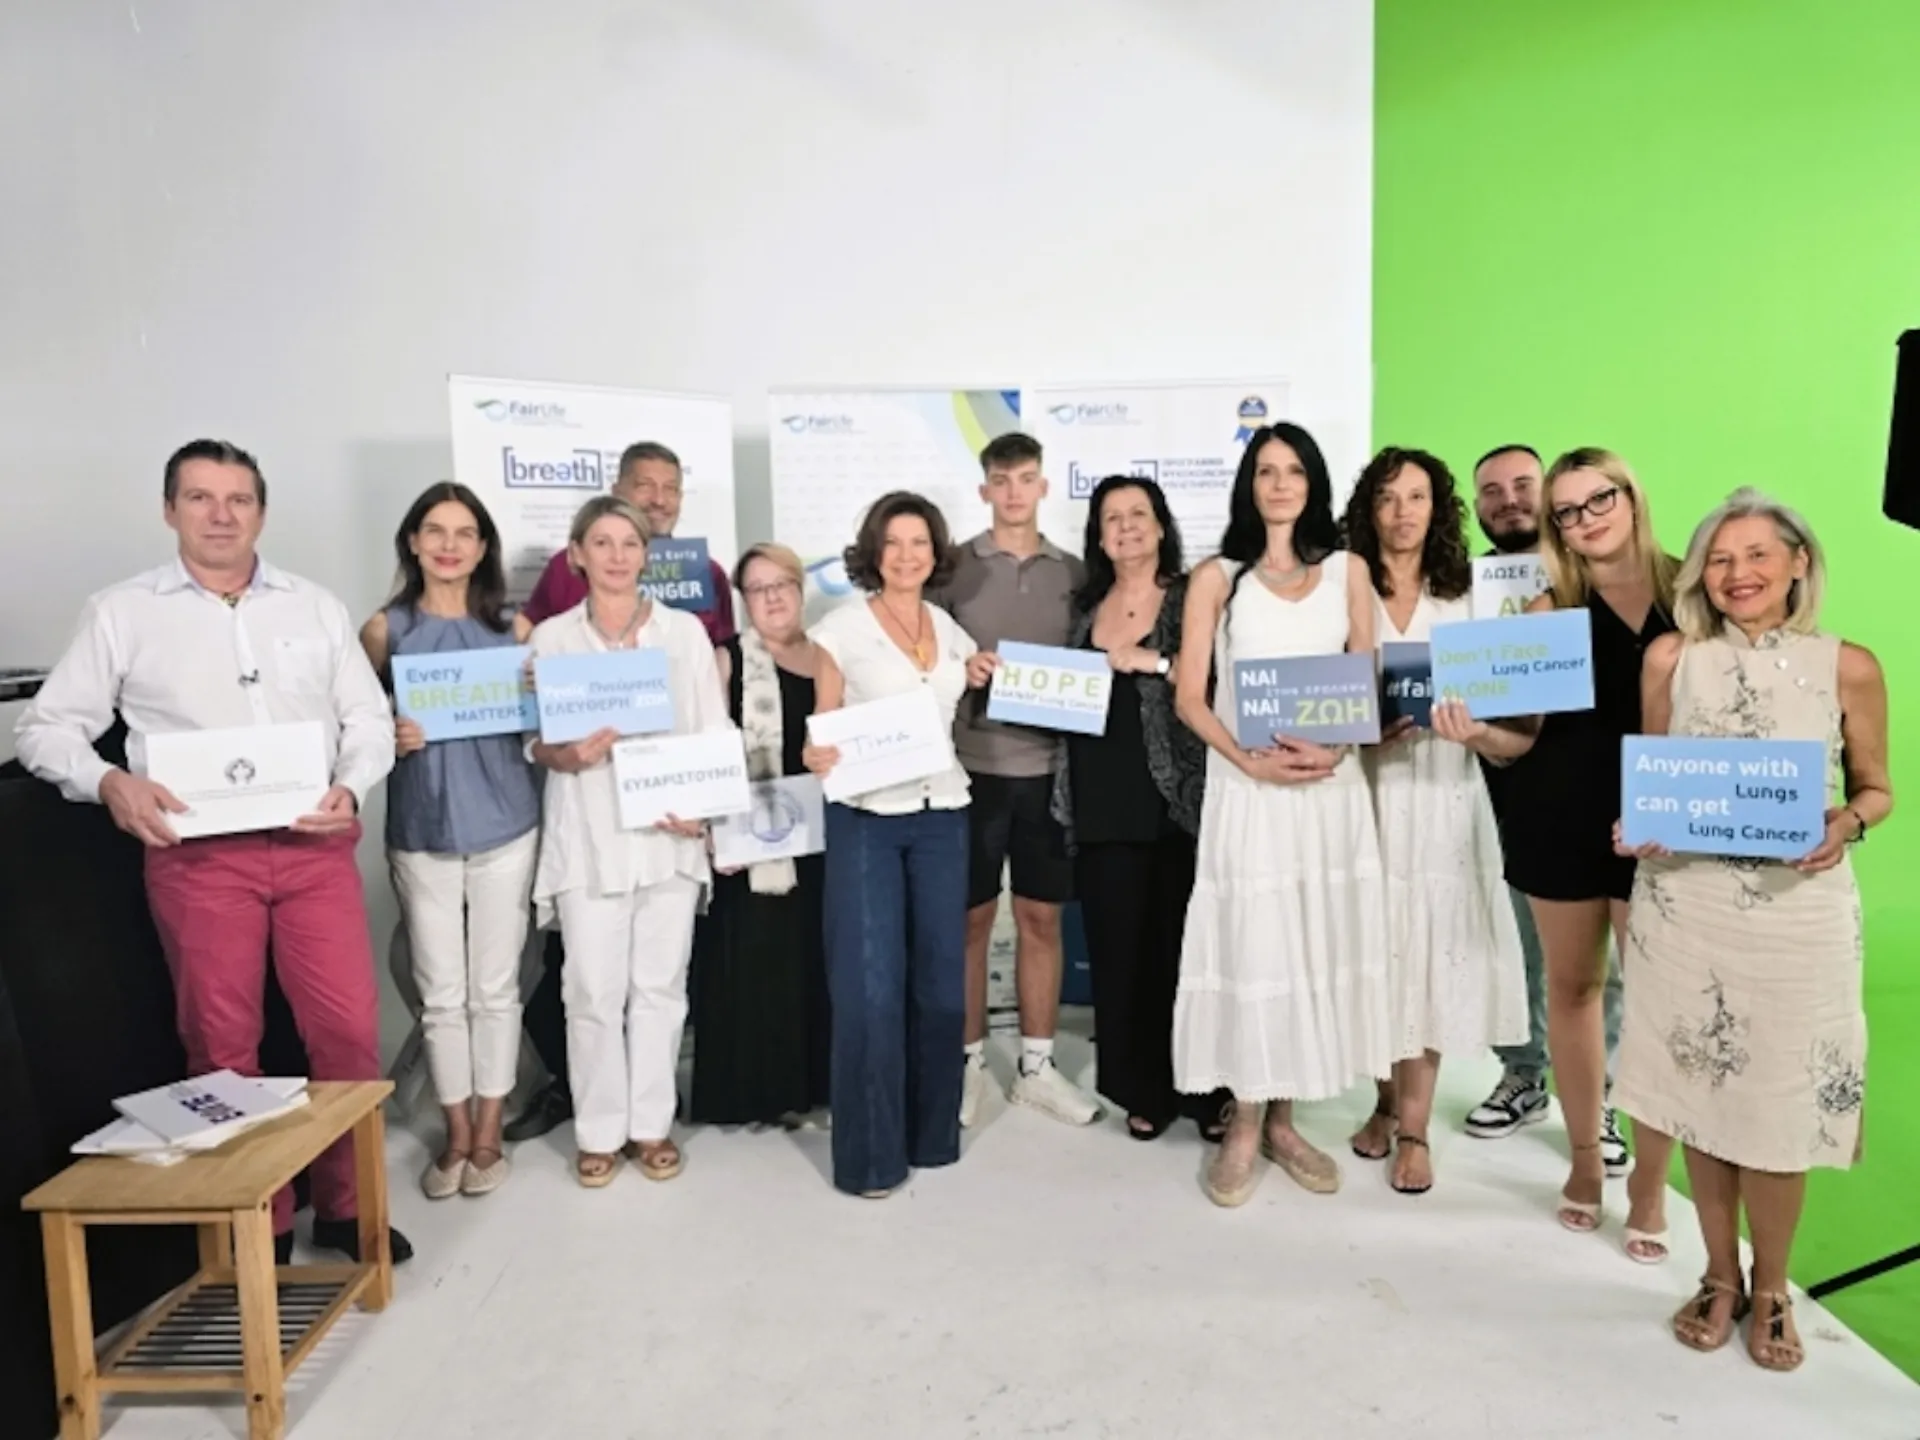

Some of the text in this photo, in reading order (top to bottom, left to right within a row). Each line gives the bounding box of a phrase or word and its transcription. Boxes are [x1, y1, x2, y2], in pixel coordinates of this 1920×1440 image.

[1482, 563, 1529, 581] ΔΩΣΕ
[1438, 643, 1549, 666] Don't Face
[405, 665, 464, 684] Every
[1491, 657, 1586, 676] Lung Cancer
[1002, 664, 1102, 698] HOPE
[1442, 679, 1510, 700] ALONE
[408, 678, 527, 711] BREATH
[453, 704, 527, 724] MATTERS
[544, 697, 630, 717] ΕΛΕΥΘΕΡΗ
[1295, 696, 1371, 728] ΖΩΗ
[1635, 753, 1799, 778] Anyone with
[1735, 783, 1799, 804] Lungs
[1635, 795, 1731, 818] can get
[1688, 822, 1811, 843] Lung Cancer
